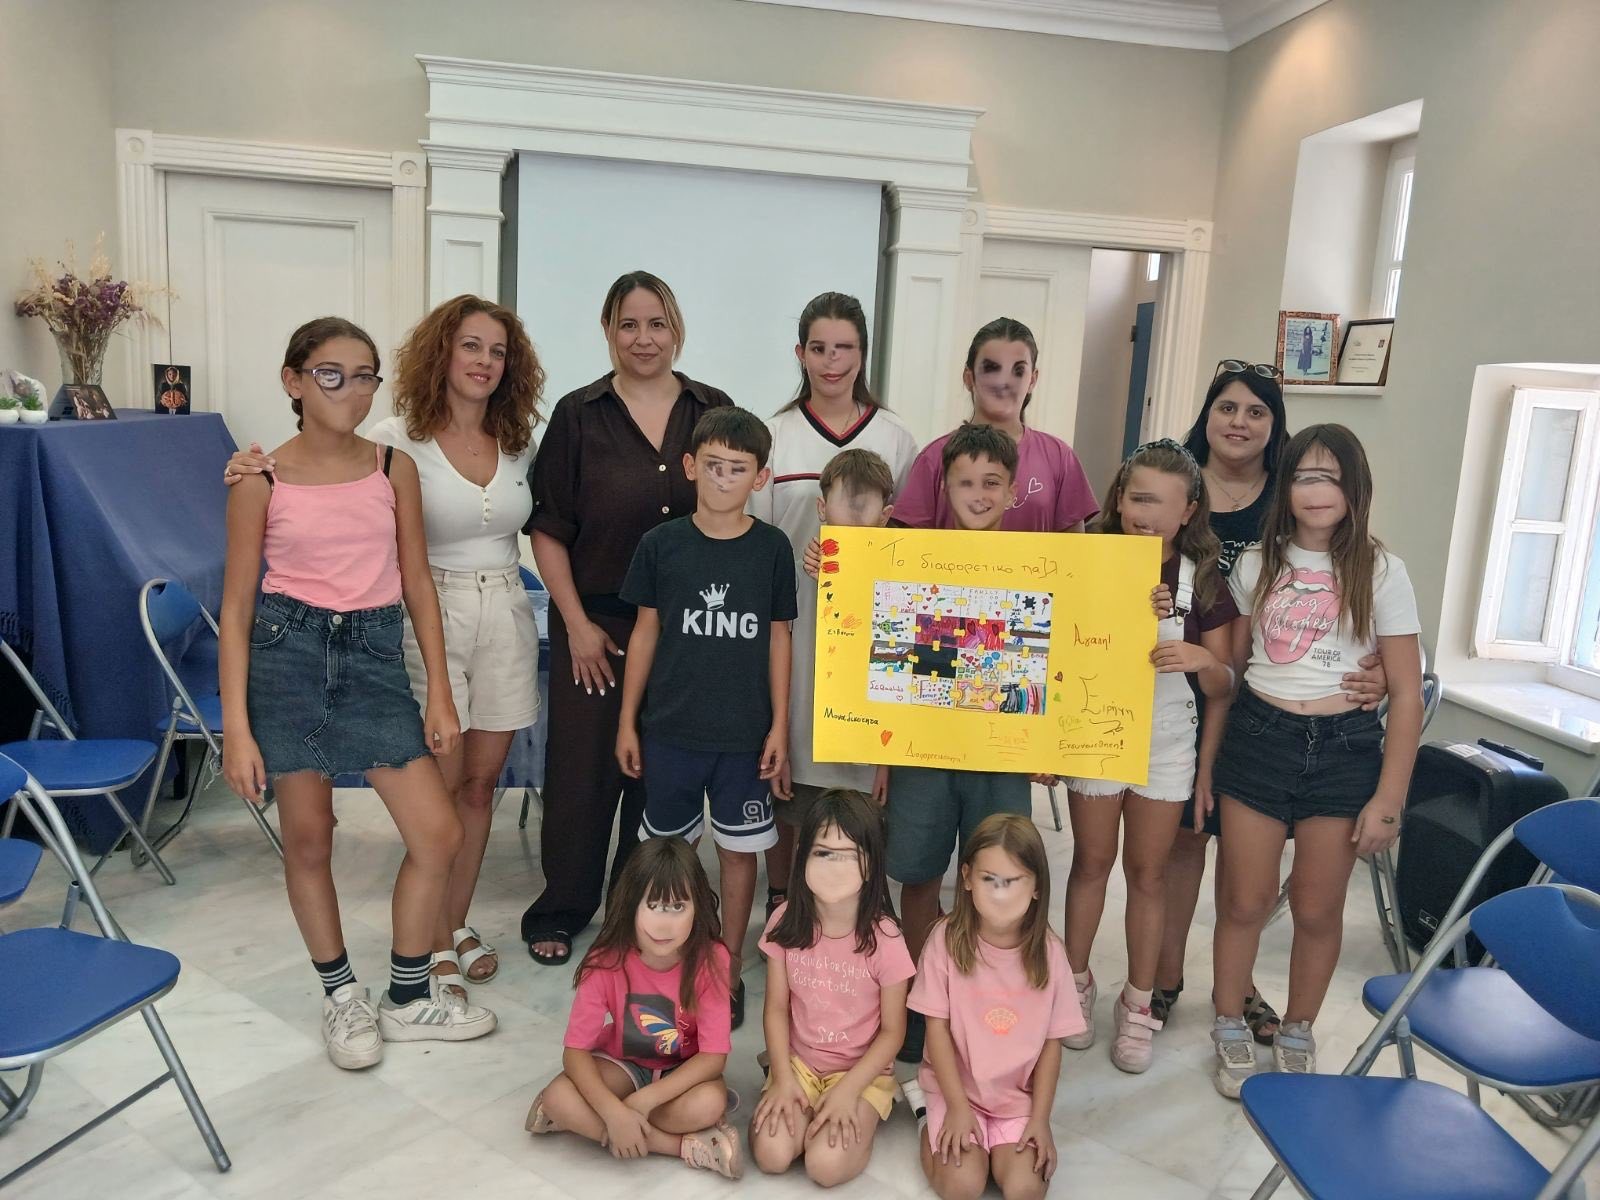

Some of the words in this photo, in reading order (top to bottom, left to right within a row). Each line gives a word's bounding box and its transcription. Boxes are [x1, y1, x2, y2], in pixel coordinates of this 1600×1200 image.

[682, 608, 759, 639] KING
[1313, 647, 1332, 655] TOUR
[1311, 654, 1341, 662] AMERICA
